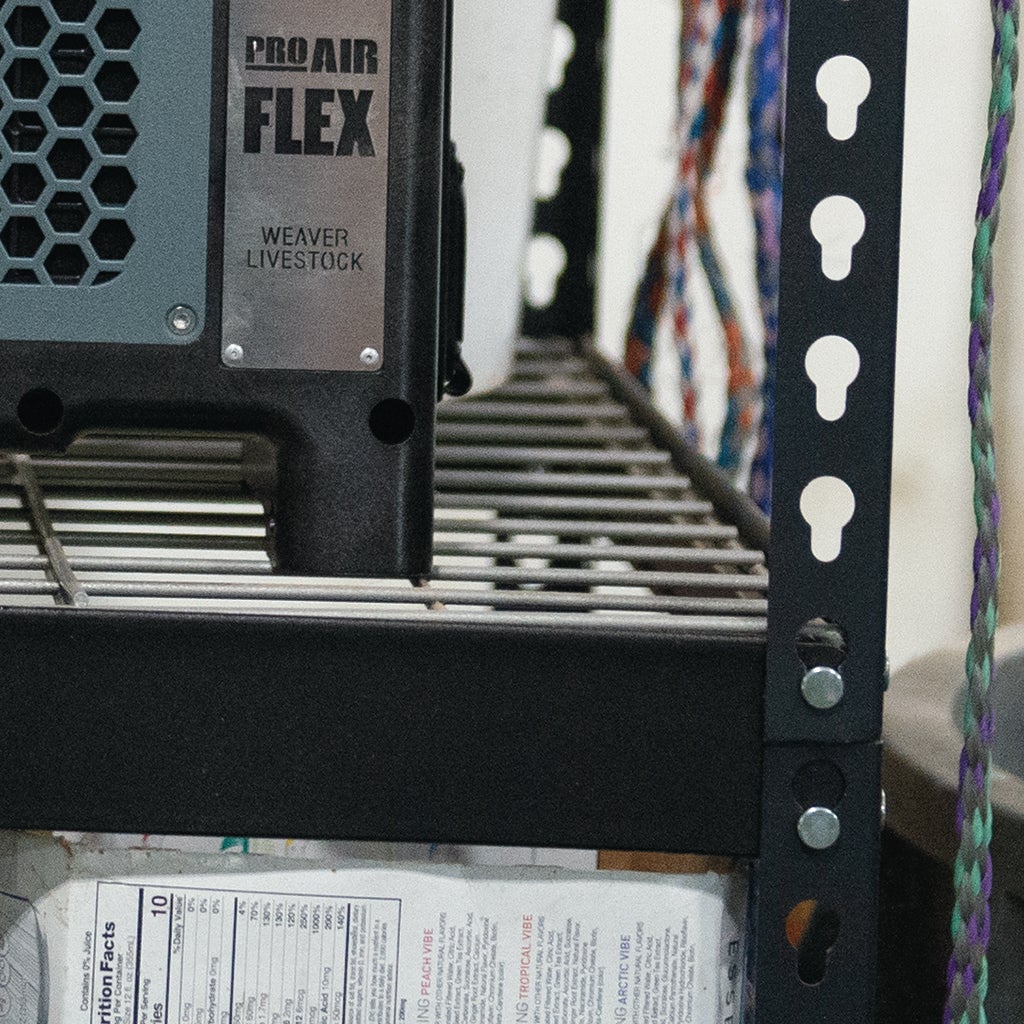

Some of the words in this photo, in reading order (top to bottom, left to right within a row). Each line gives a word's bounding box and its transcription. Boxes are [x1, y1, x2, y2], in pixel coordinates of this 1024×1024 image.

[243, 87, 376, 157] FLEX
[261, 226, 349, 248] WEAVER
[246, 250, 363, 272] LIVESTOCK
[150, 895, 168, 917] 10
[173, 923, 184, 945] Daily
[423, 928, 433, 954] VIBE
[522, 914, 533, 941] VIBE
[83, 931, 92, 954] Juice
[100, 922, 115, 971] Facts
[619, 934, 631, 960] VIBE
[114, 953, 123, 996] Container
[420, 957, 432, 996] PEACH
[519, 944, 531, 999] TROPICAL
[617, 963, 629, 1005] ARCTIC
[80, 973, 90, 1011] Contains
[142, 979, 150, 1010] Serving
[319, 993, 329, 1013] Acid
